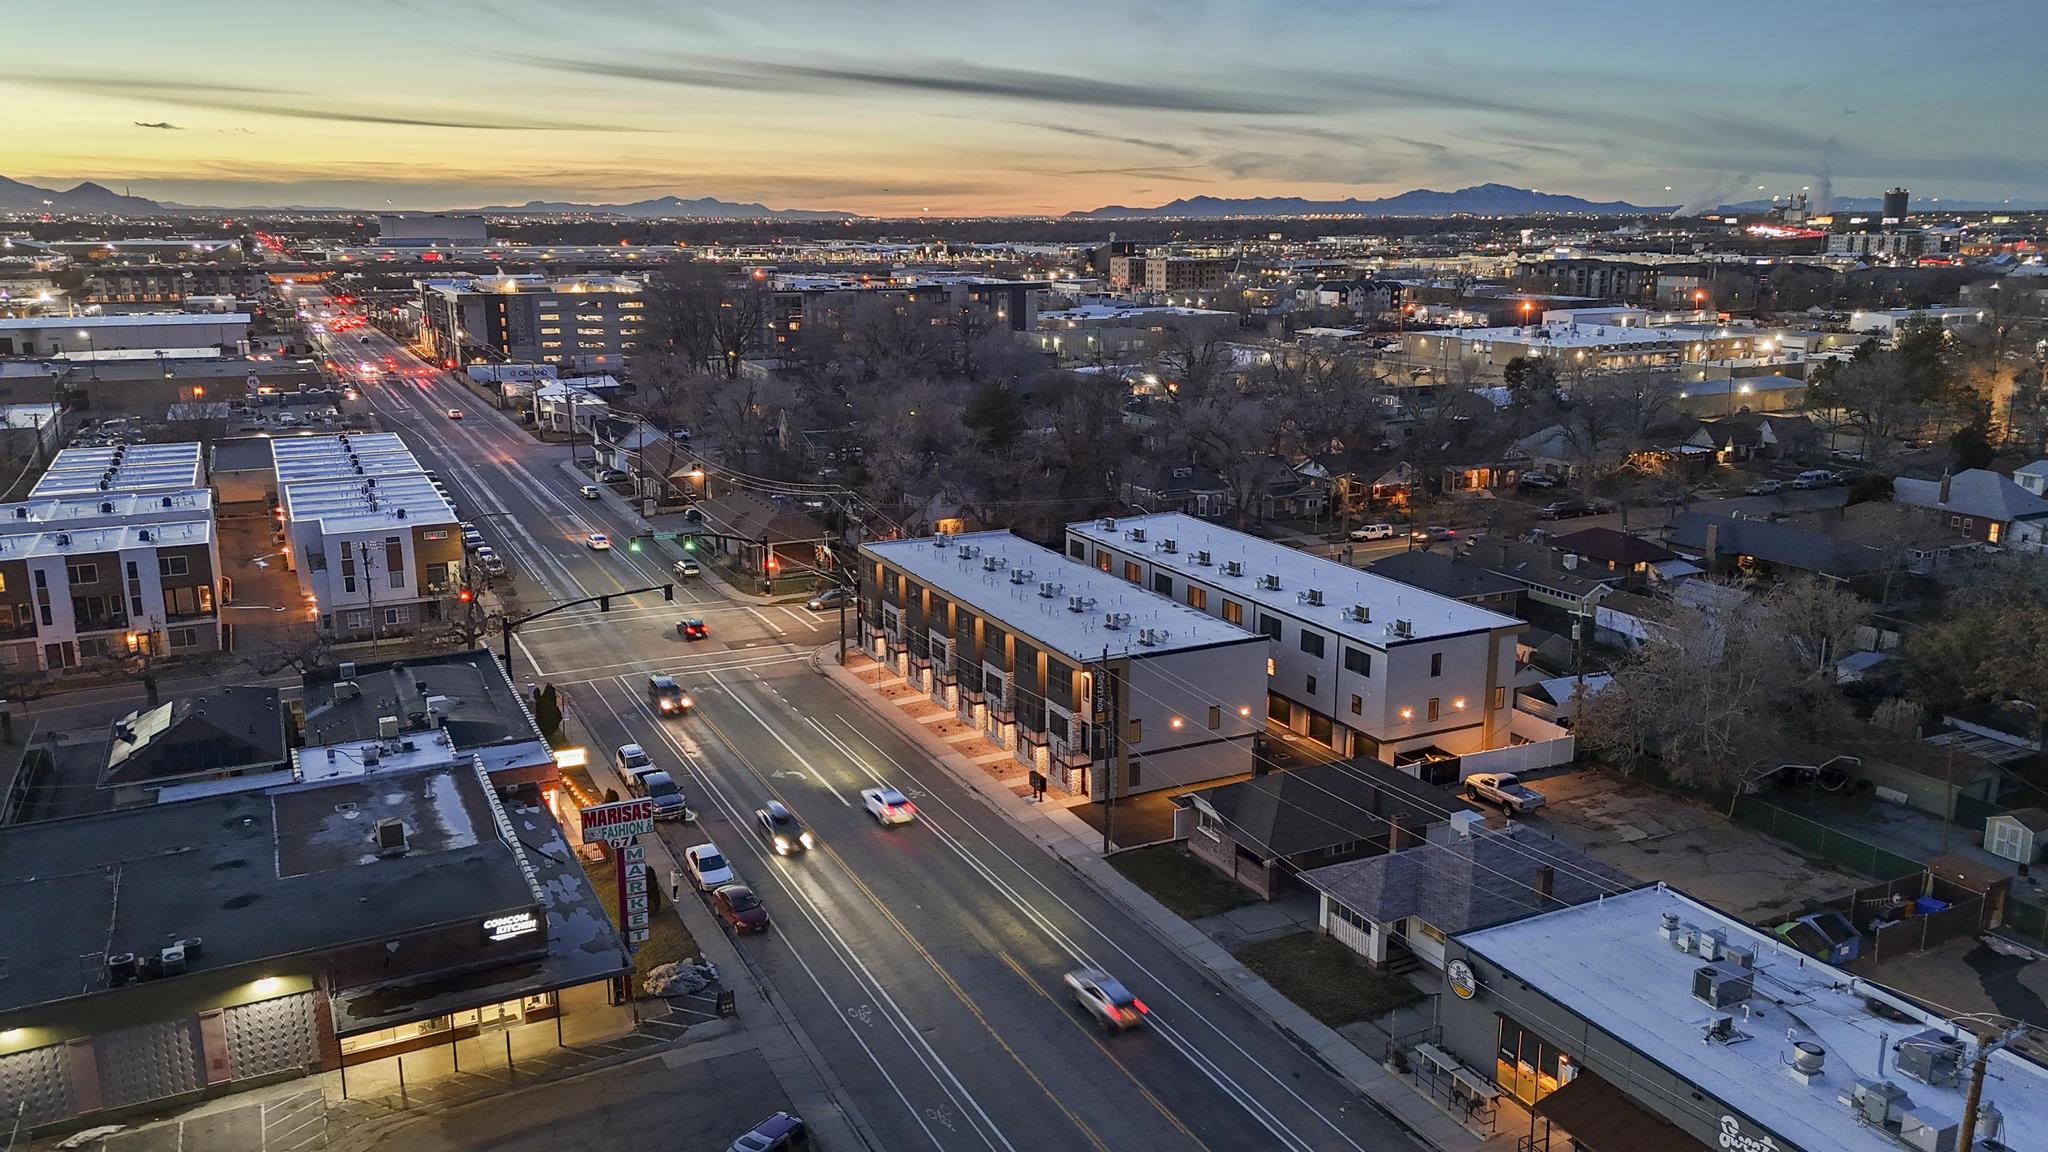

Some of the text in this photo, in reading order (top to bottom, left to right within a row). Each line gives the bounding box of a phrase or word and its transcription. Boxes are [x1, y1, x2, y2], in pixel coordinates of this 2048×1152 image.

[518, 369, 548, 377] OKLAND
[582, 802, 652, 828] MARISAS
[601, 821, 653, 838] FASHION &
[626, 848, 644, 940] MARKET
[483, 912, 530, 929] COMCOM
[496, 919, 537, 935] KITCHEN
